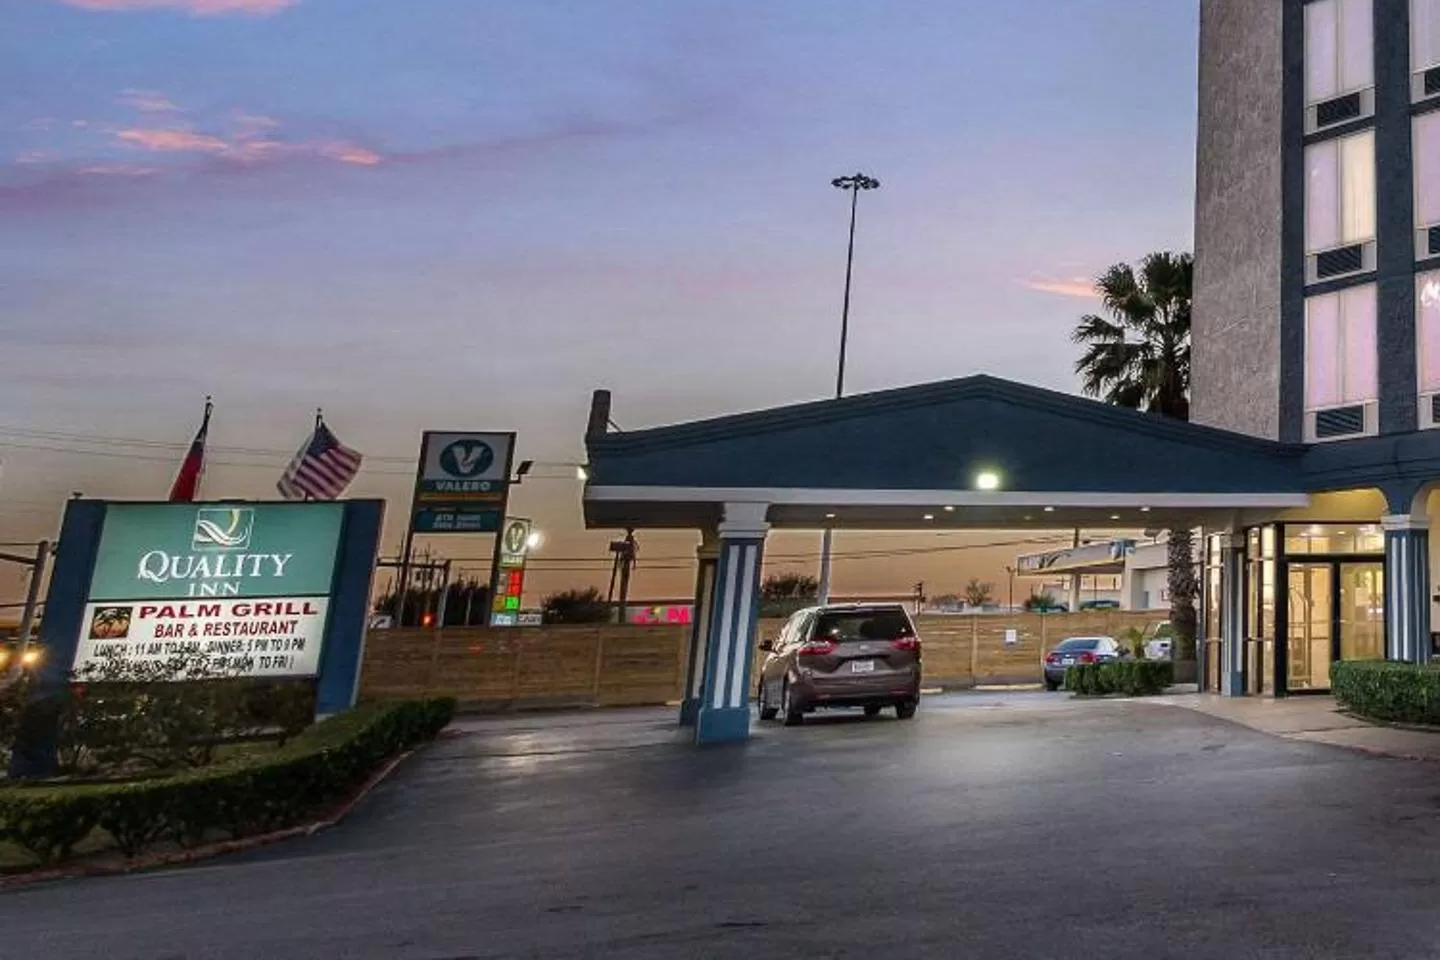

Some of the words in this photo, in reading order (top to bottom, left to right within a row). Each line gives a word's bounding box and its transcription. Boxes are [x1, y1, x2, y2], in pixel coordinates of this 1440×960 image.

[137, 550, 293, 583] QUALITY
[188, 581, 241, 596] INN
[139, 604, 222, 619] PALM
[231, 602, 318, 616] GRILL
[154, 624, 185, 638] BAR
[187, 625, 199, 637] &
[202, 620, 299, 636] RESTAURANT
[135, 643, 146, 655] 11
[147, 642, 162, 654] AM
[255, 639, 270, 651] PM
[271, 639, 283, 651] TO
[291, 638, 307, 651] PM
[259, 655, 272, 668] TO
